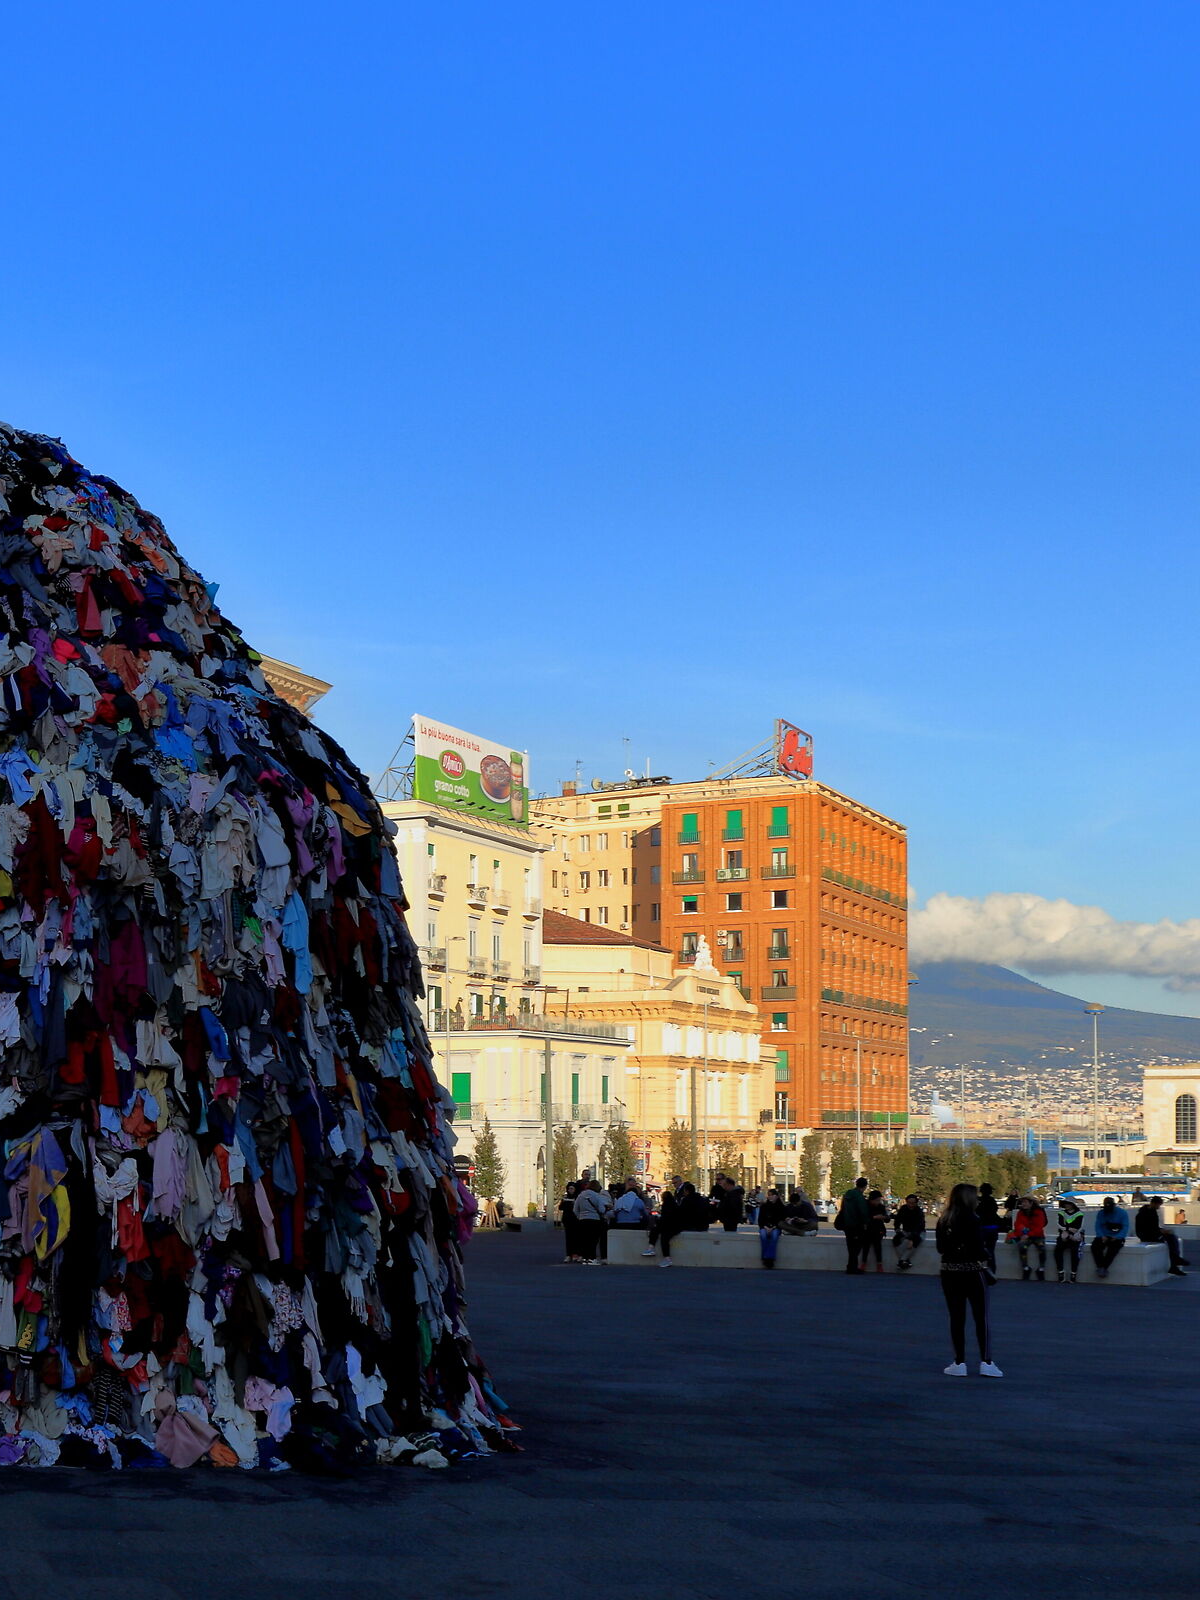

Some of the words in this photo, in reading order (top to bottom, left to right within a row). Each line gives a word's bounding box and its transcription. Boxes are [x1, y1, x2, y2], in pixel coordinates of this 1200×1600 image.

[421, 723, 427, 735] La
[438, 730, 455, 744] buona
[434, 780, 453, 793] grano
[454, 785, 470, 798] cotto
